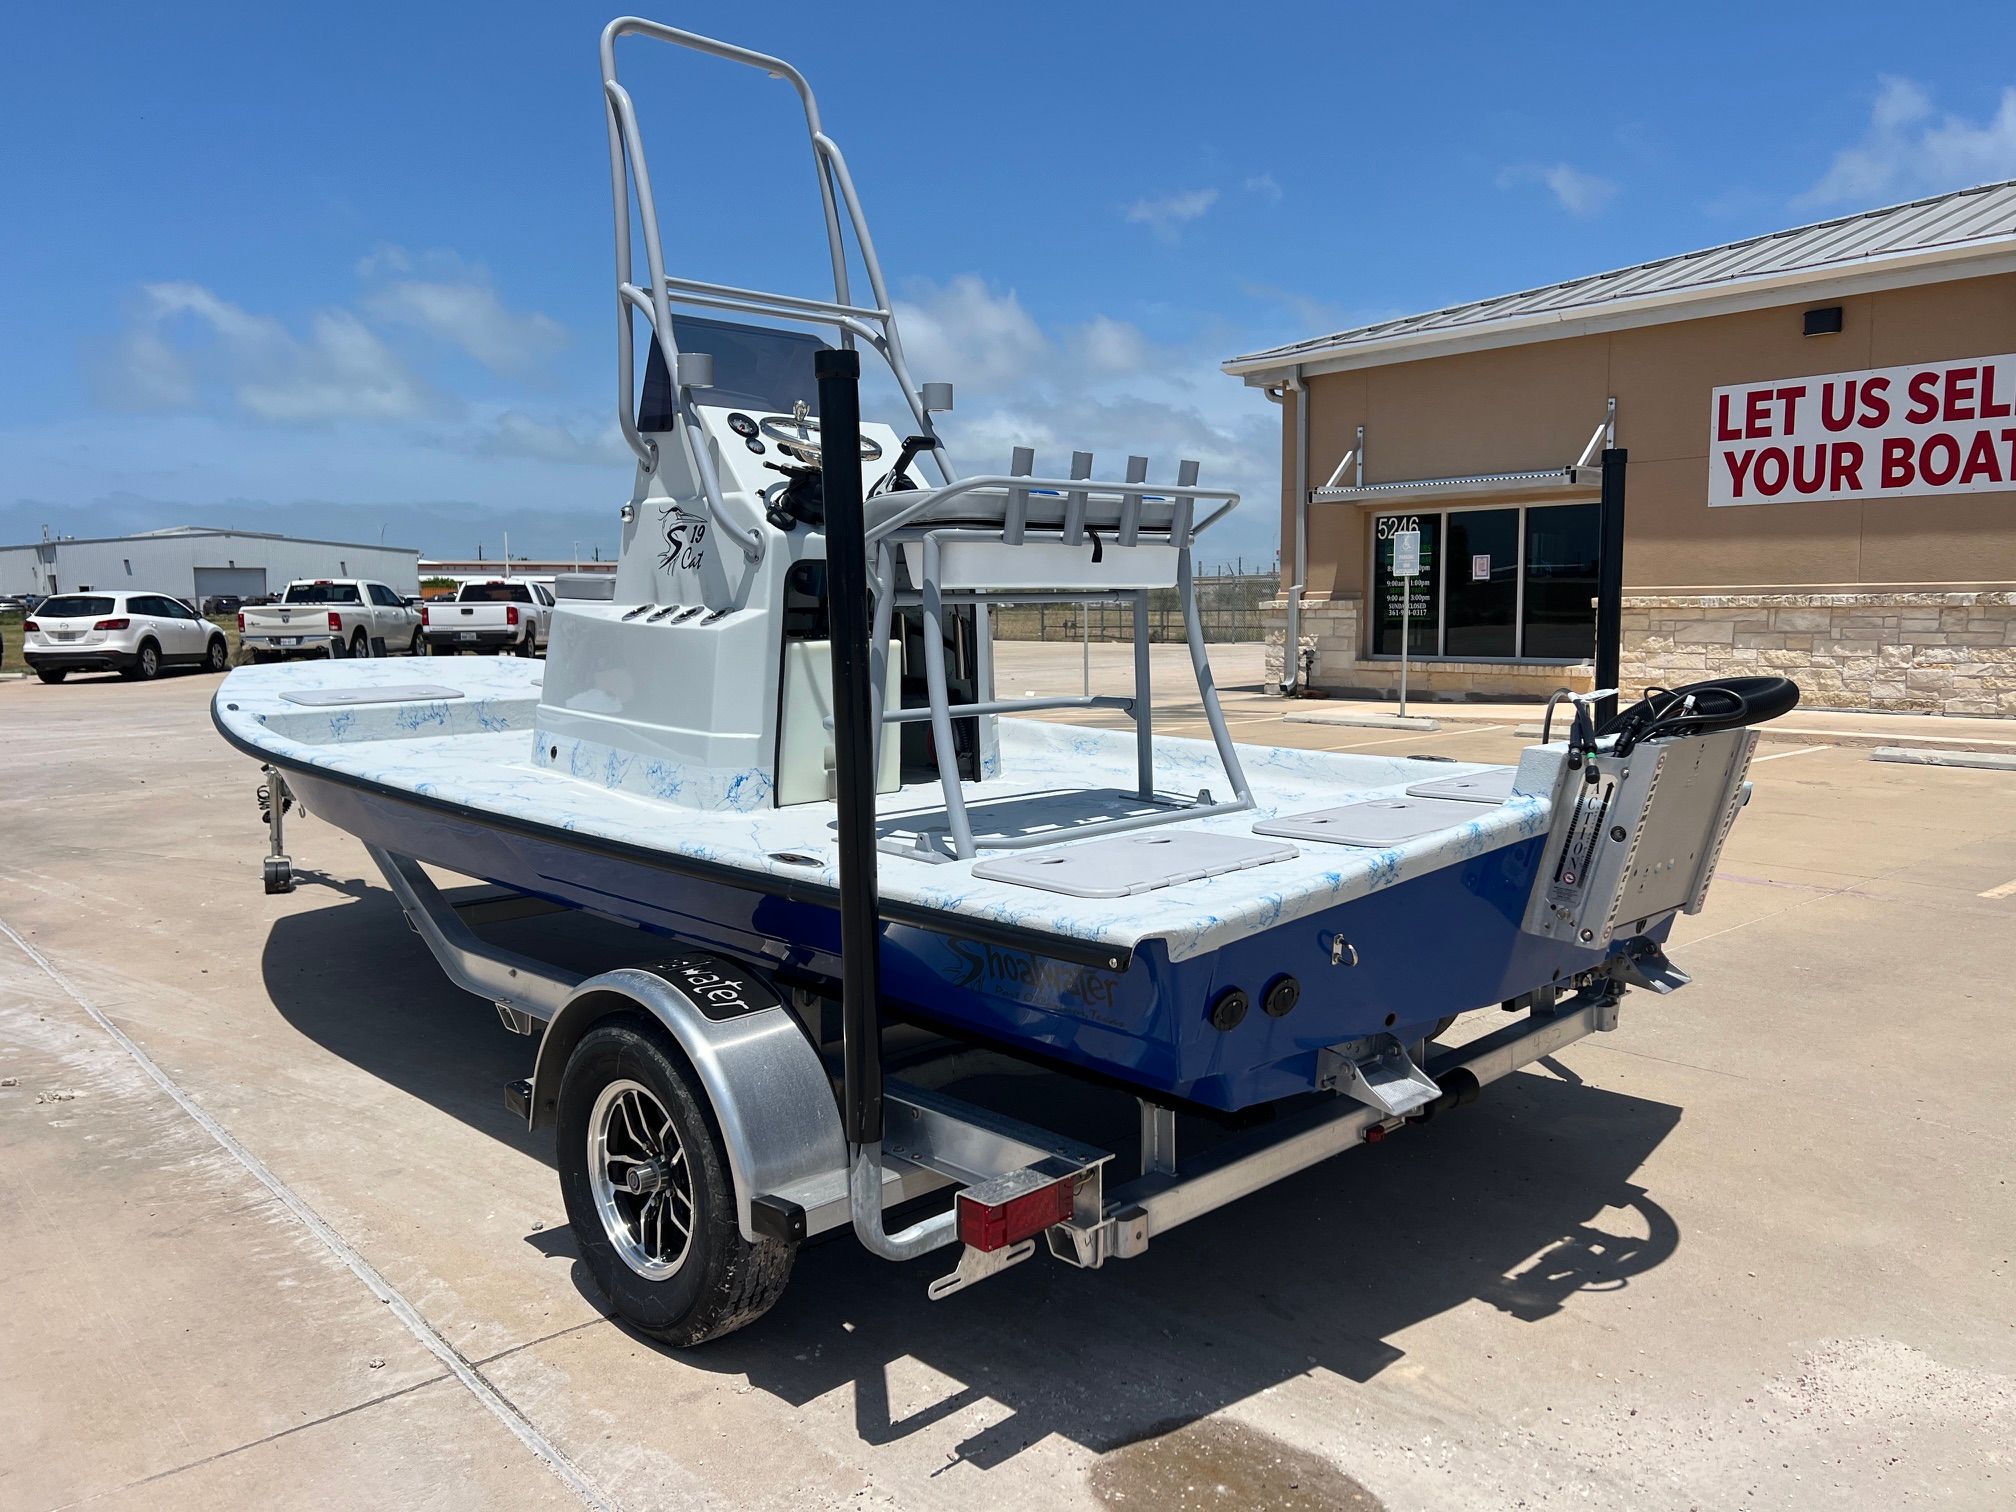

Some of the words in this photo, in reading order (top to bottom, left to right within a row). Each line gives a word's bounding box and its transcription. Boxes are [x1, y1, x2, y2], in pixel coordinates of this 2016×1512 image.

[1717, 385, 1807, 442] LET
[1821, 377, 1892, 432] US
[1904, 365, 2016, 425] SEL
[1723, 441, 1864, 498] YOUR
[690, 524, 706, 544] 19
[1377, 516, 1420, 540] 5246
[681, 546, 704, 570] Cat
